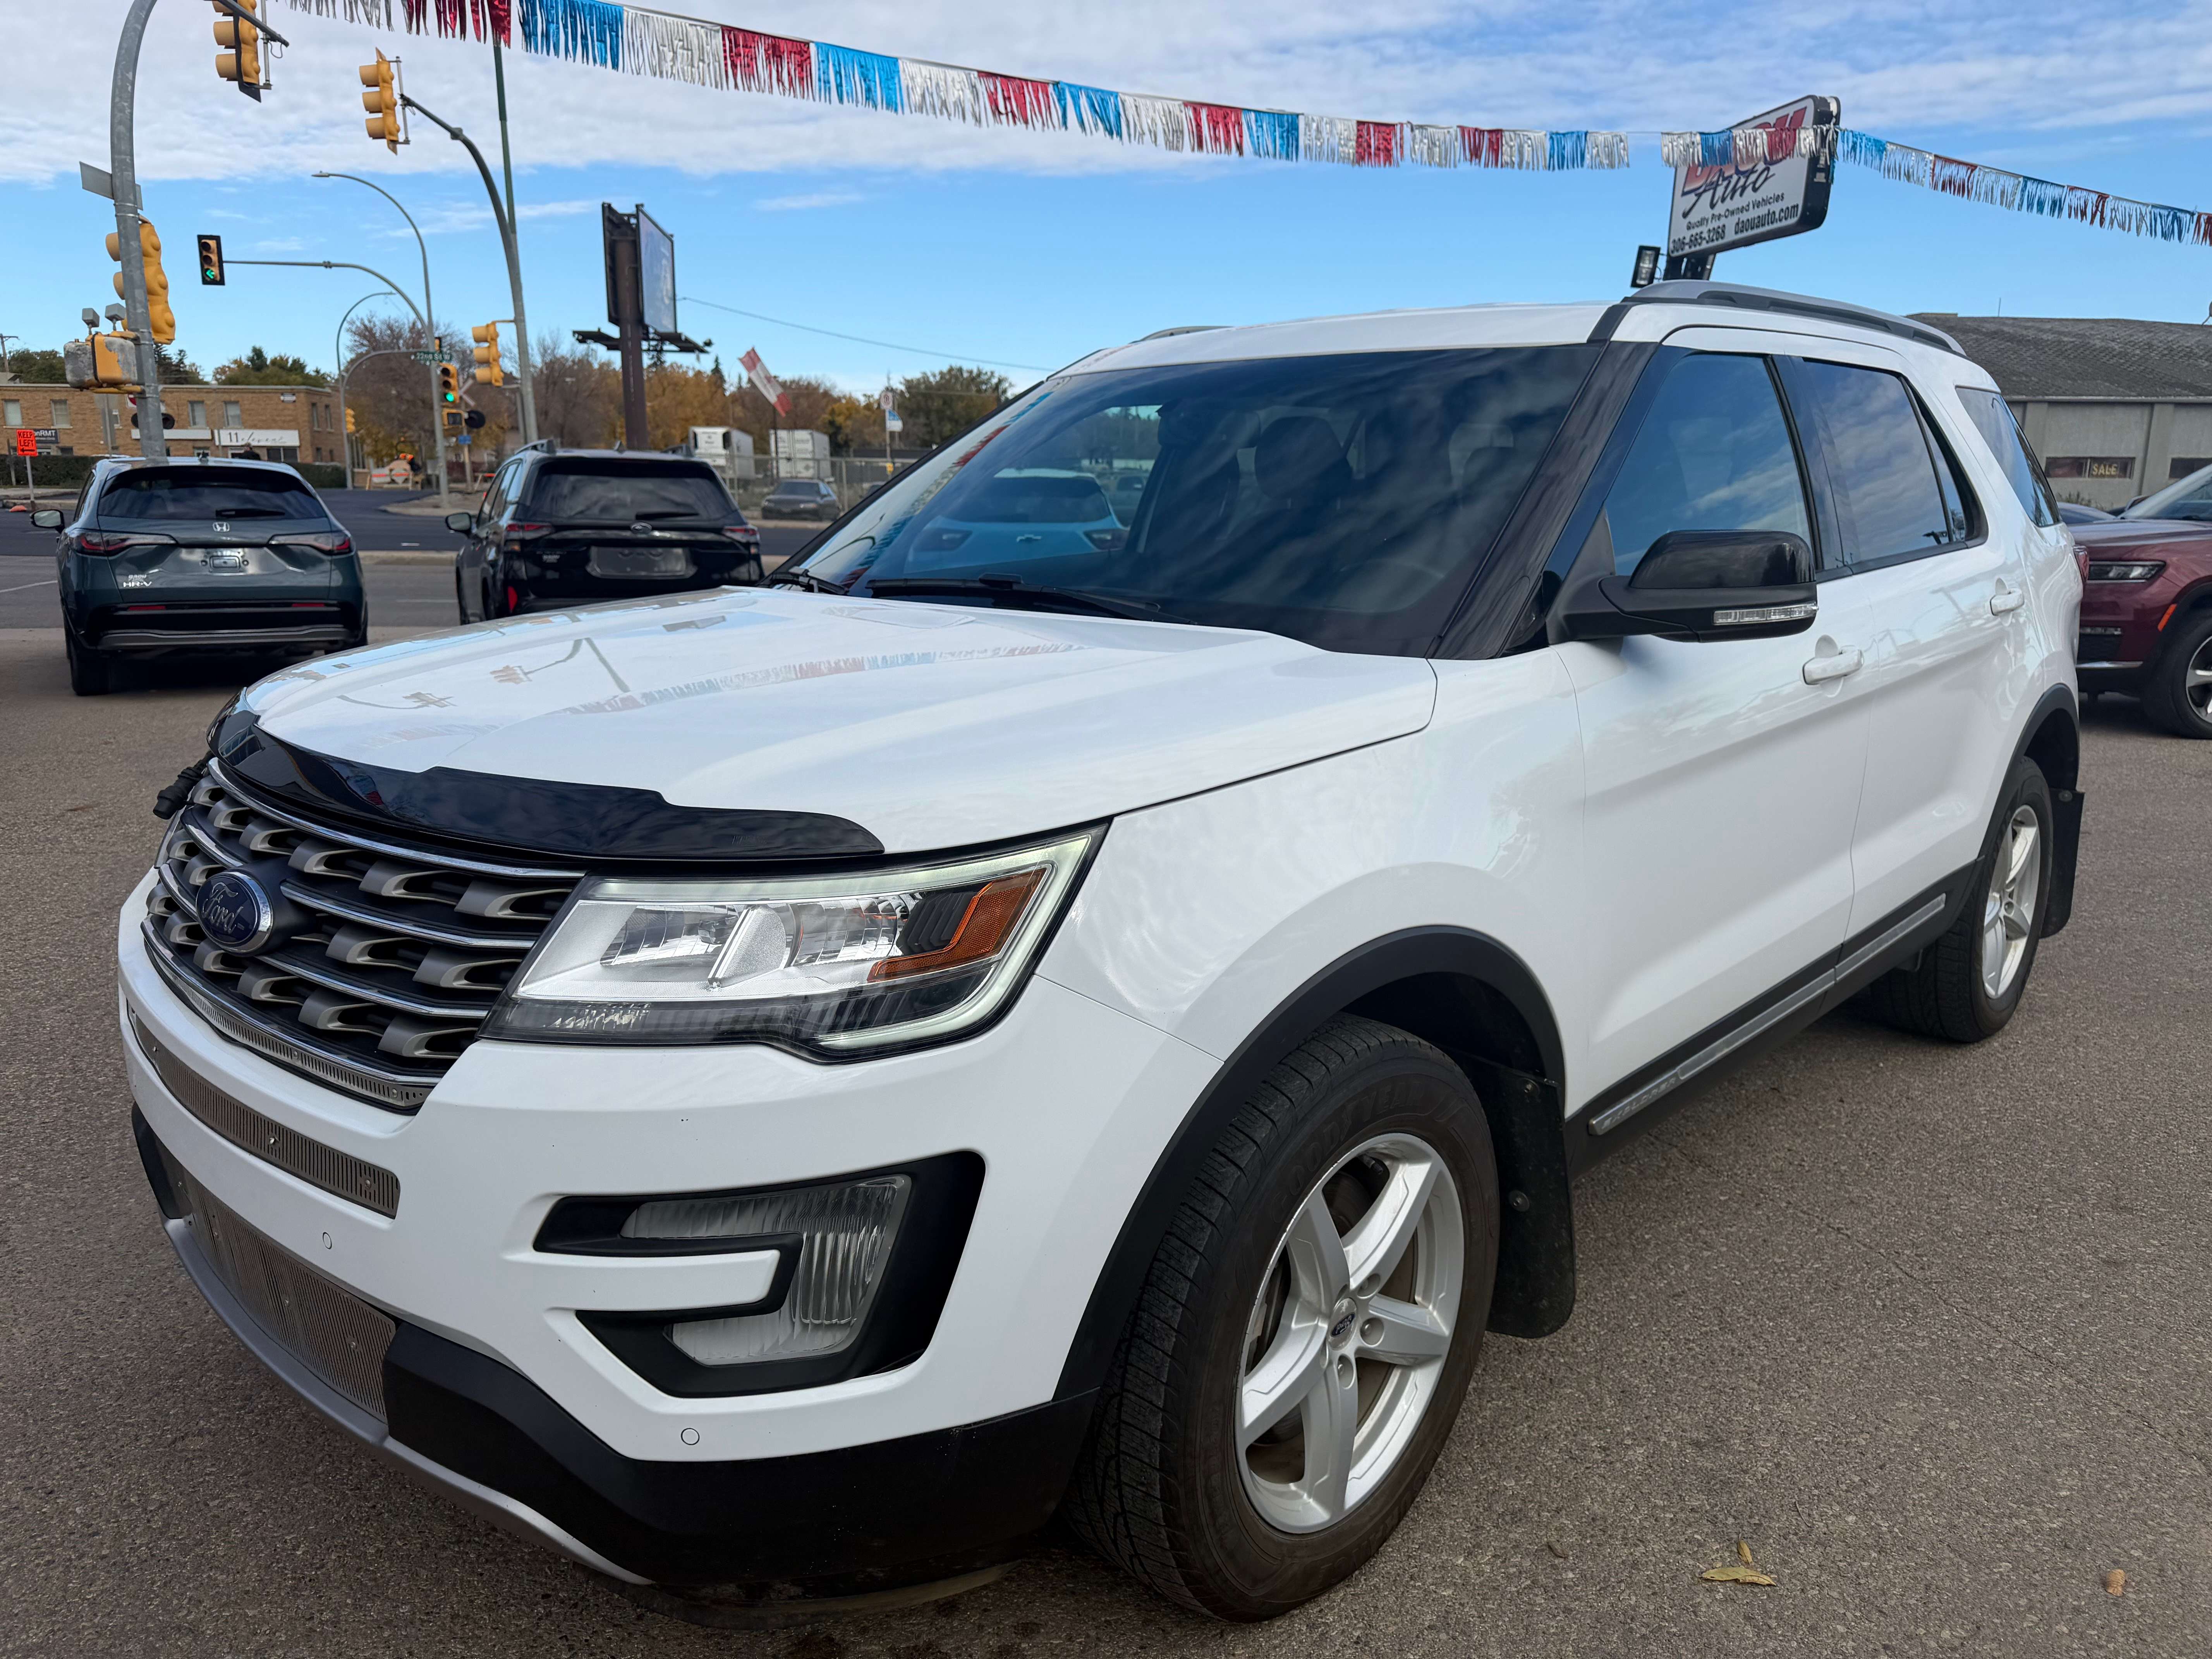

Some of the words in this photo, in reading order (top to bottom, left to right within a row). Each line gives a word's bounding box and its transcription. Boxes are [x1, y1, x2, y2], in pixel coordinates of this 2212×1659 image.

[1682, 161, 1776, 219] Auto
[1686, 216, 1709, 230] Quality
[1711, 201, 1750, 223] Pre-Owned
[1752, 192, 1784, 210] Vehicles
[1671, 223, 1726, 254] 306-665-3268
[1734, 203, 1799, 235] daouauto.com
[228, 432, 238, 443] 11
[2093, 464, 2118, 476] SALE
[201, 882, 245, 934] Ford
